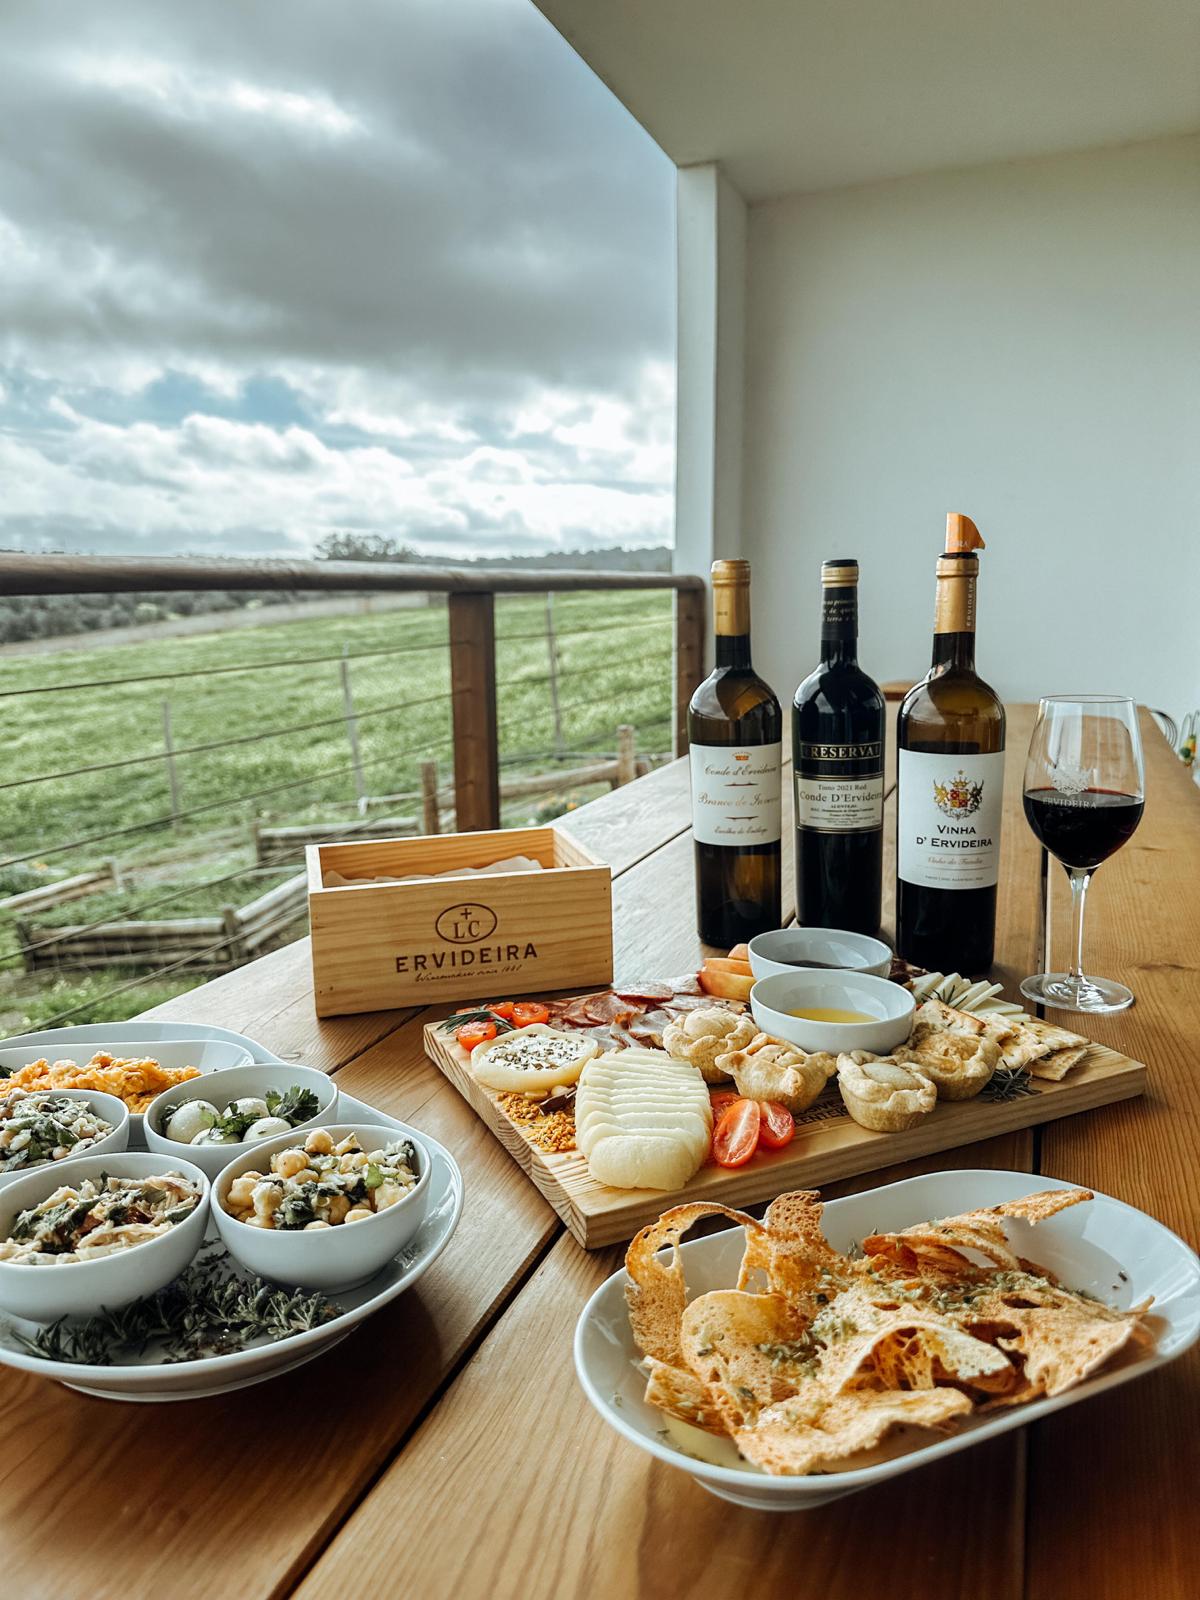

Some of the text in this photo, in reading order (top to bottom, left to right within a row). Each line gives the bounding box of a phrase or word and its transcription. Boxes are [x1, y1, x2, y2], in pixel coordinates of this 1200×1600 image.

[811, 746, 874, 758] RESERVA
[799, 791, 827, 802] Conde
[937, 824, 976, 835] VINHA
[931, 837, 992, 848] ERVIDEIRA
[396, 943, 538, 973] ERVIDEIRA
